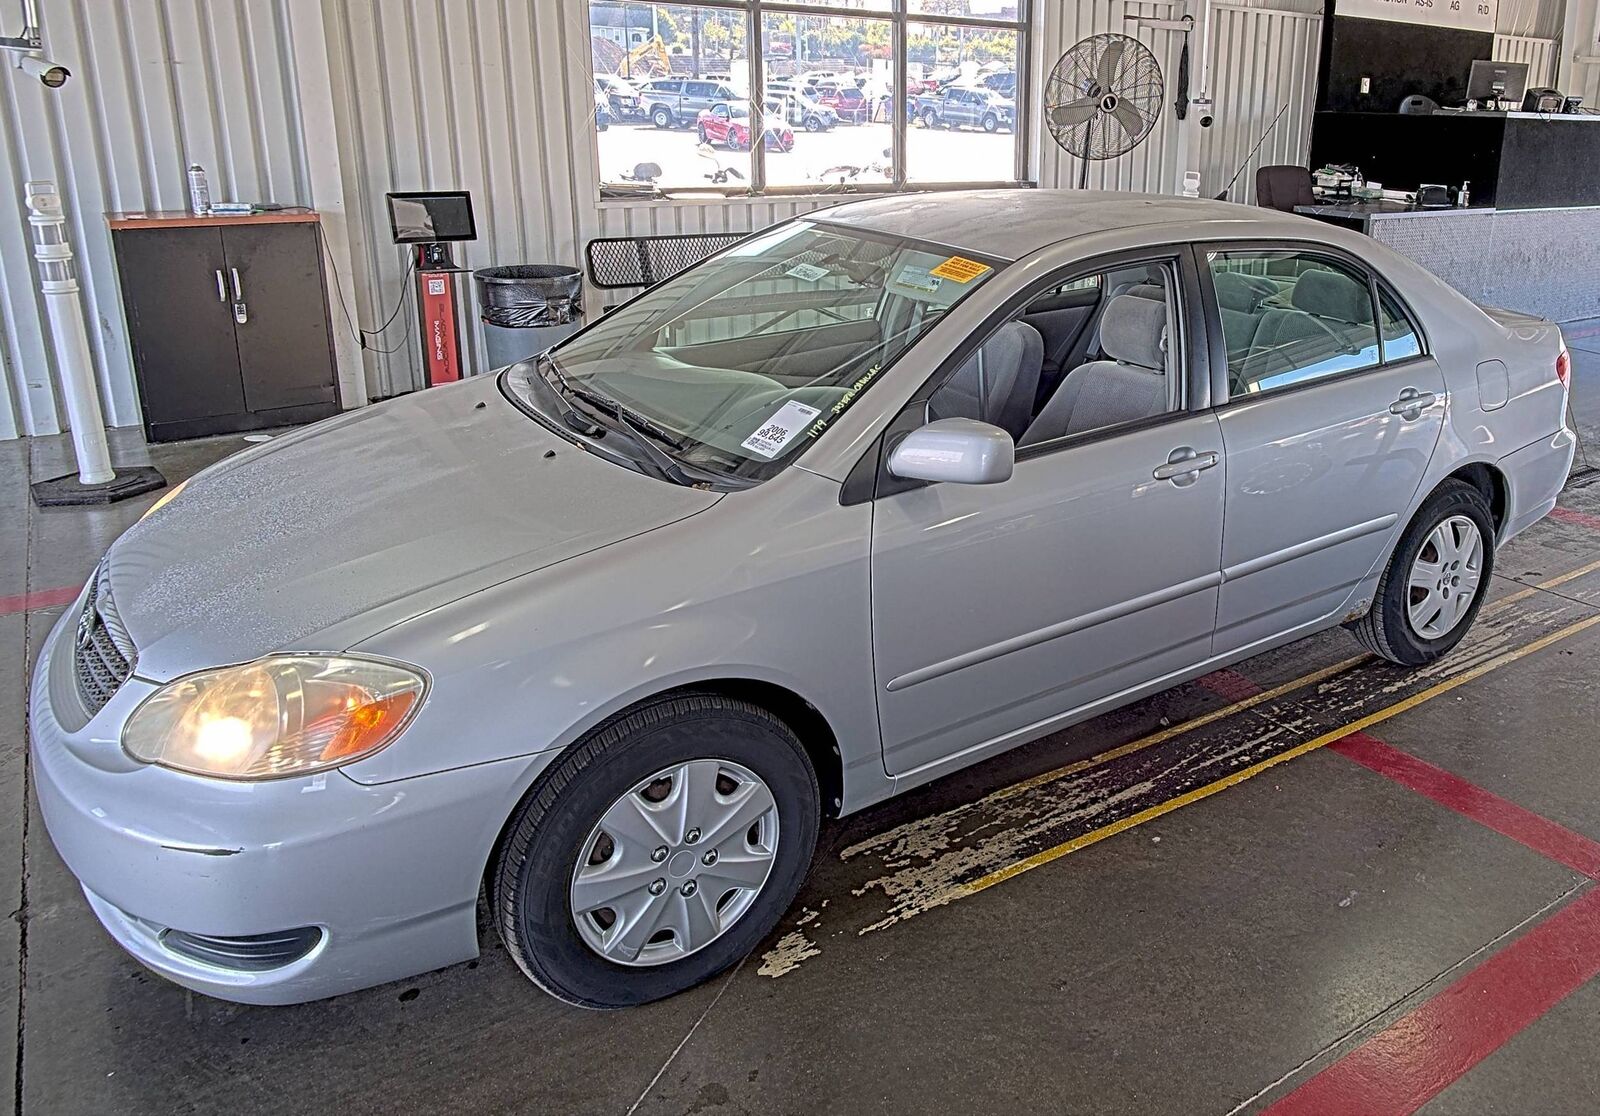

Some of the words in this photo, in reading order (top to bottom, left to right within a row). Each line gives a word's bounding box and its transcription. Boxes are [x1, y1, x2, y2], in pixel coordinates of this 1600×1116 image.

[1450, 1, 1460, 11] AG
[434, 320, 443, 360] IMAGING
[757, 428, 785, 444] 99,645
[766, 424, 788, 436] 2006
[807, 419, 827, 438] 1179
